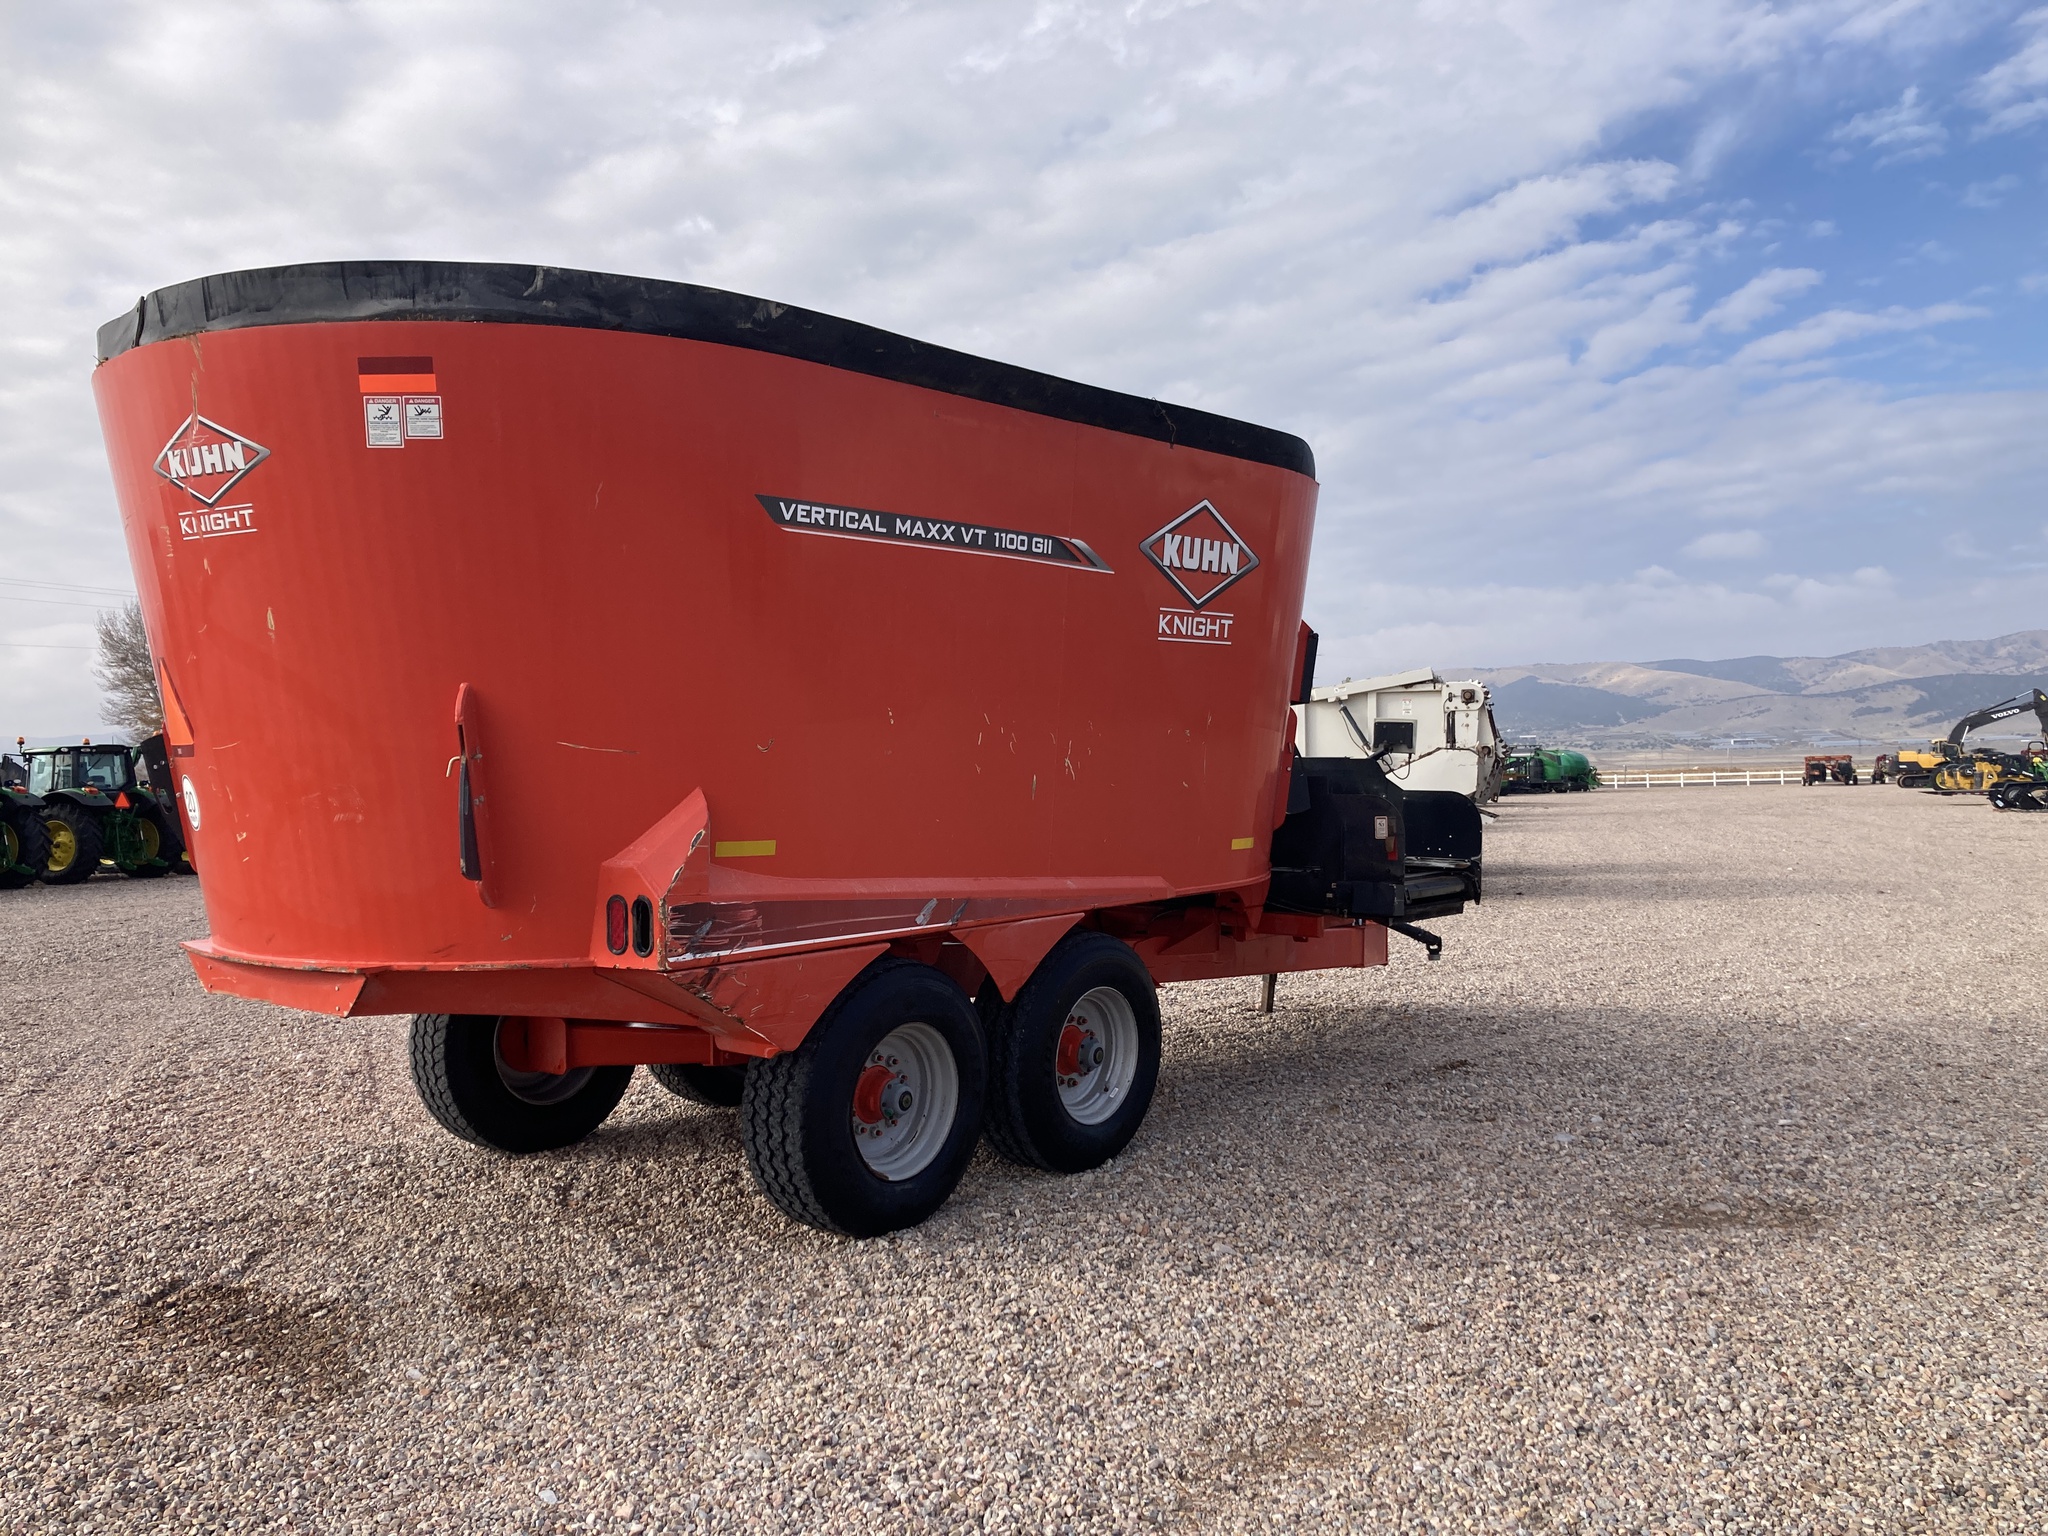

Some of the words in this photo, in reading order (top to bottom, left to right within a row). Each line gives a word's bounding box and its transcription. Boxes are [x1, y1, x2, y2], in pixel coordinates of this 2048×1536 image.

[166, 441, 246, 479] KUHN
[779, 501, 887, 533] VERTICAL
[895, 517, 956, 542] MAXX
[961, 526, 987, 546] VT
[993, 532, 1028, 552] 1100
[1031, 537, 1052, 555] GII
[1162, 533, 1240, 575] KUHN
[1158, 614, 1233, 638] KNIGHT
[1990, 708, 2020, 719] VOLVO
[185, 791, 196, 812] 20
